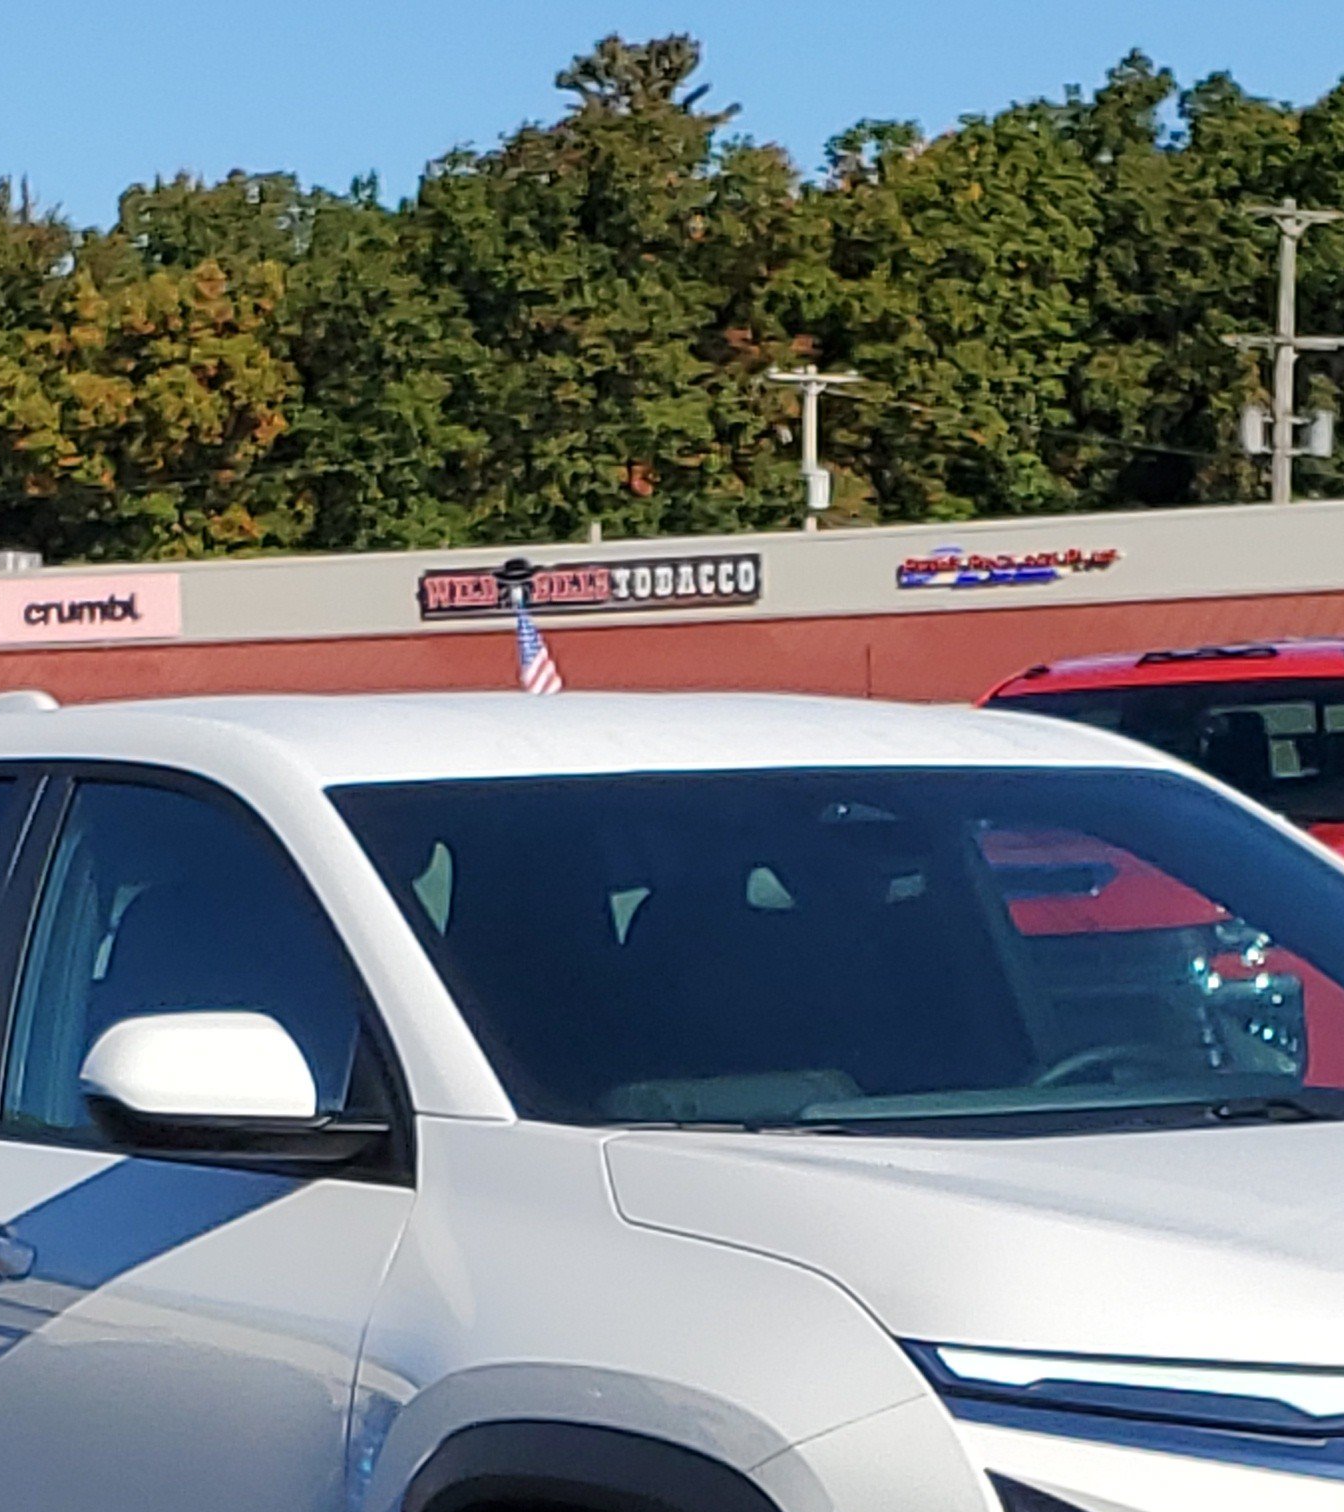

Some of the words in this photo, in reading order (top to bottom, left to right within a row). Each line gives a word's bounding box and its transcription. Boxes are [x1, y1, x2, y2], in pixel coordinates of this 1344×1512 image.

[425, 575, 498, 609] WILD
[612, 560, 755, 600] TOBACCO
[23, 592, 142, 626] crumbl
